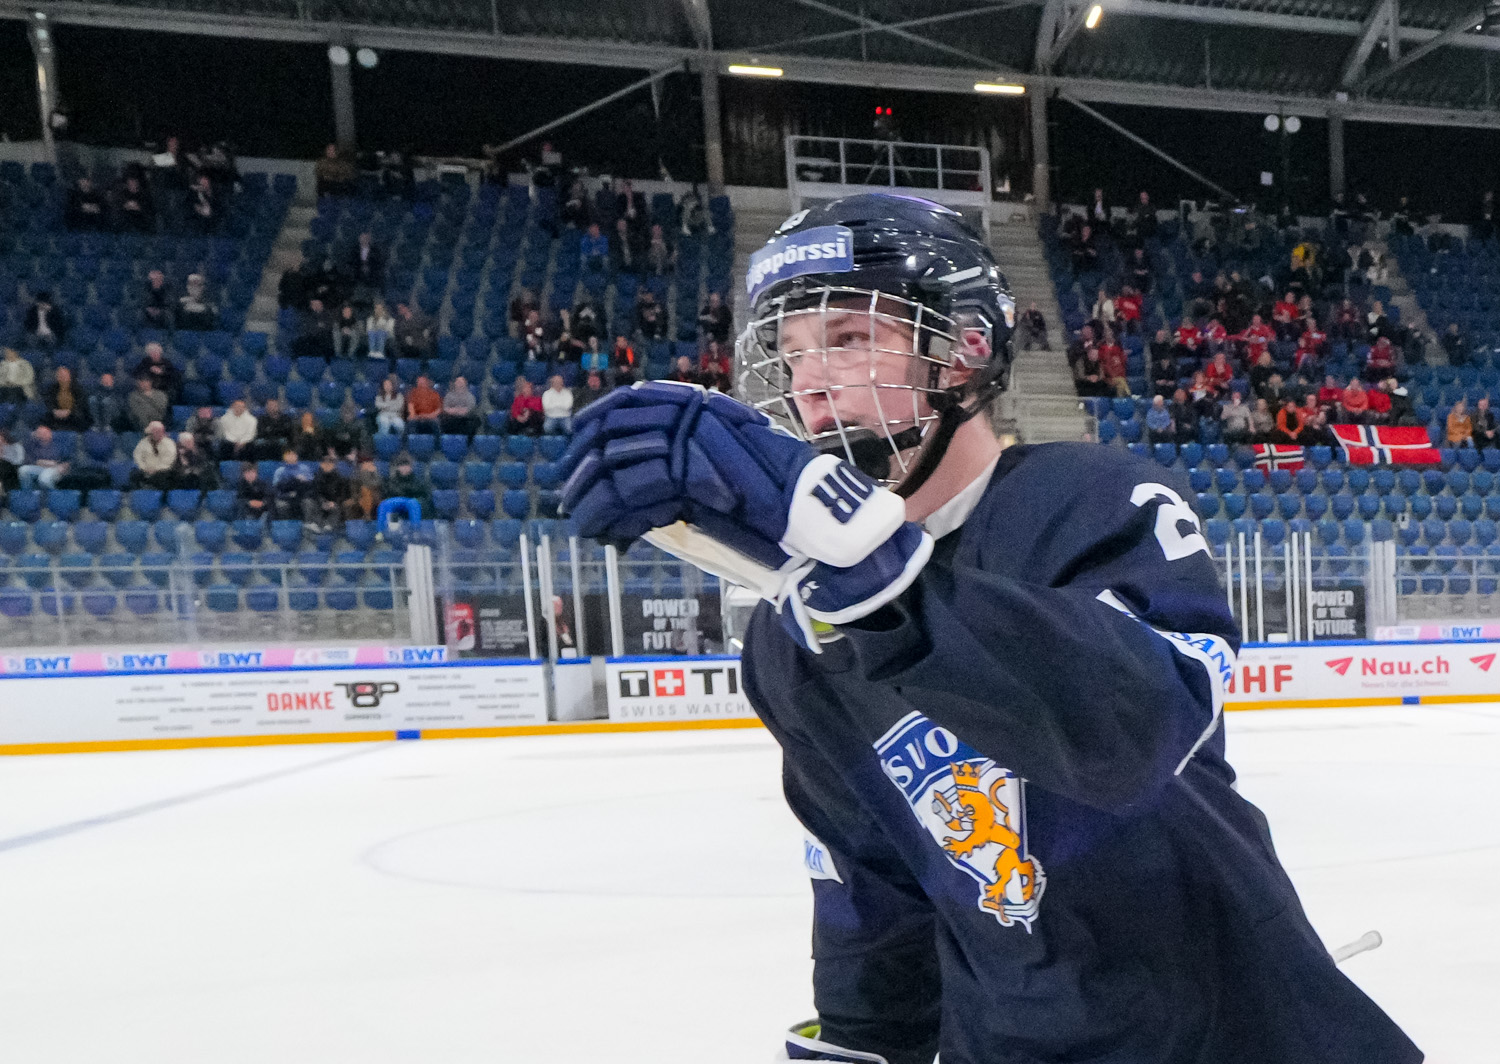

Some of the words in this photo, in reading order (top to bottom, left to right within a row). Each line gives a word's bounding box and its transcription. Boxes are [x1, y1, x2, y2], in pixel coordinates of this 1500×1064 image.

[1451, 626, 1483, 639] BWT
[122, 654, 169, 670] BWT
[219, 652, 263, 669] BWT
[403, 647, 446, 662] BWT
[24, 657, 72, 671] BWT
[1361, 655, 1450, 676] Nau.ch
[266, 691, 335, 712] DANKE
[620, 704, 677, 719] SWISS
